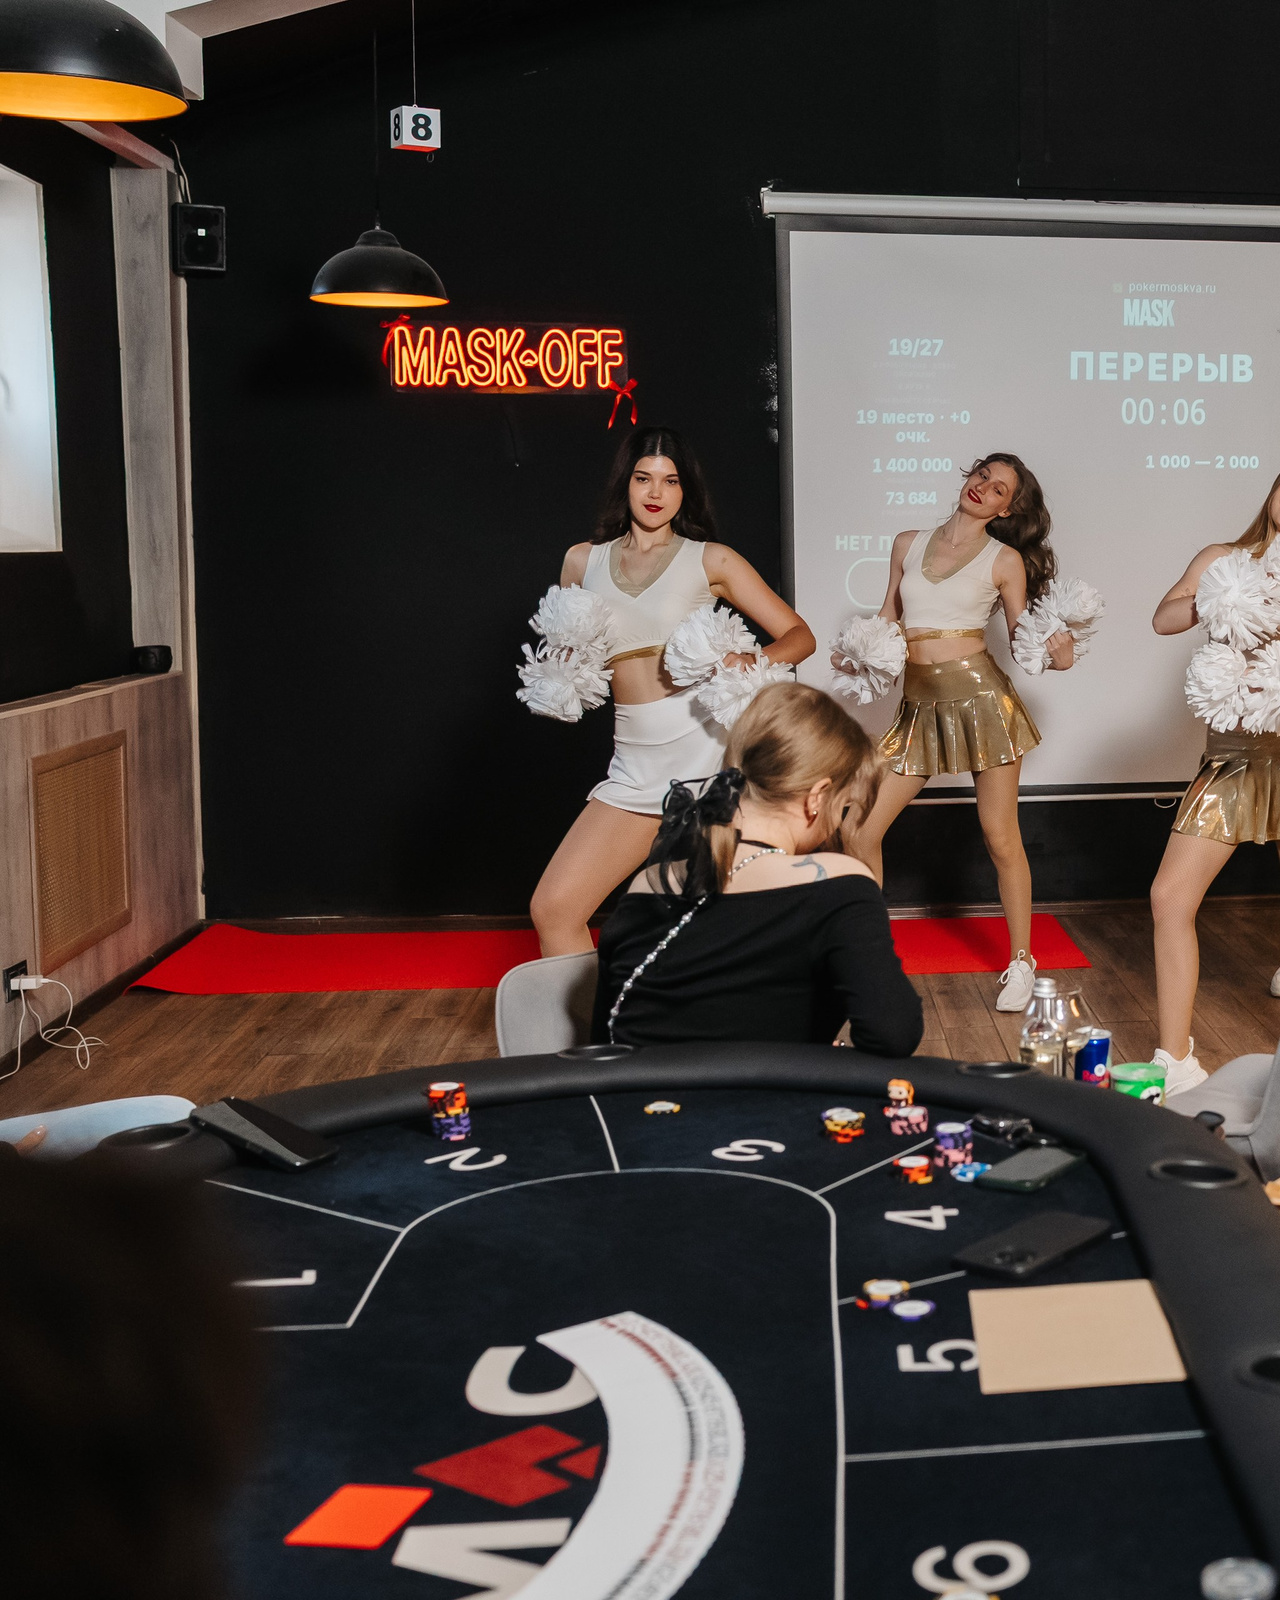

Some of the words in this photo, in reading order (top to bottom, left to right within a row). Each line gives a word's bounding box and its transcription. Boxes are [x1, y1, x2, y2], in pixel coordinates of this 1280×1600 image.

[394, 113, 401, 141] 8
[411, 113, 433, 141] 8
[1128, 281, 1217, 294] pokermoskva.ru
[1123, 298, 1176, 327] MASK
[888, 337, 944, 358] 19/27
[1070, 350, 1254, 384] ПЕРЕРЫВ
[856, 409, 878, 425] 19
[882, 412, 935, 425] место
[950, 410, 971, 425] +0
[1121, 397, 1206, 426] 00:06
[895, 431, 931, 443] очк.
[835, 535, 873, 551] НЕТ
[423, 1146, 508, 1172] 2
[711, 1138, 786, 1162] 3
[884, 1205, 960, 1231] 4
[896, 1338, 980, 1373] 5
[911, 1539, 1031, 1595] 6
